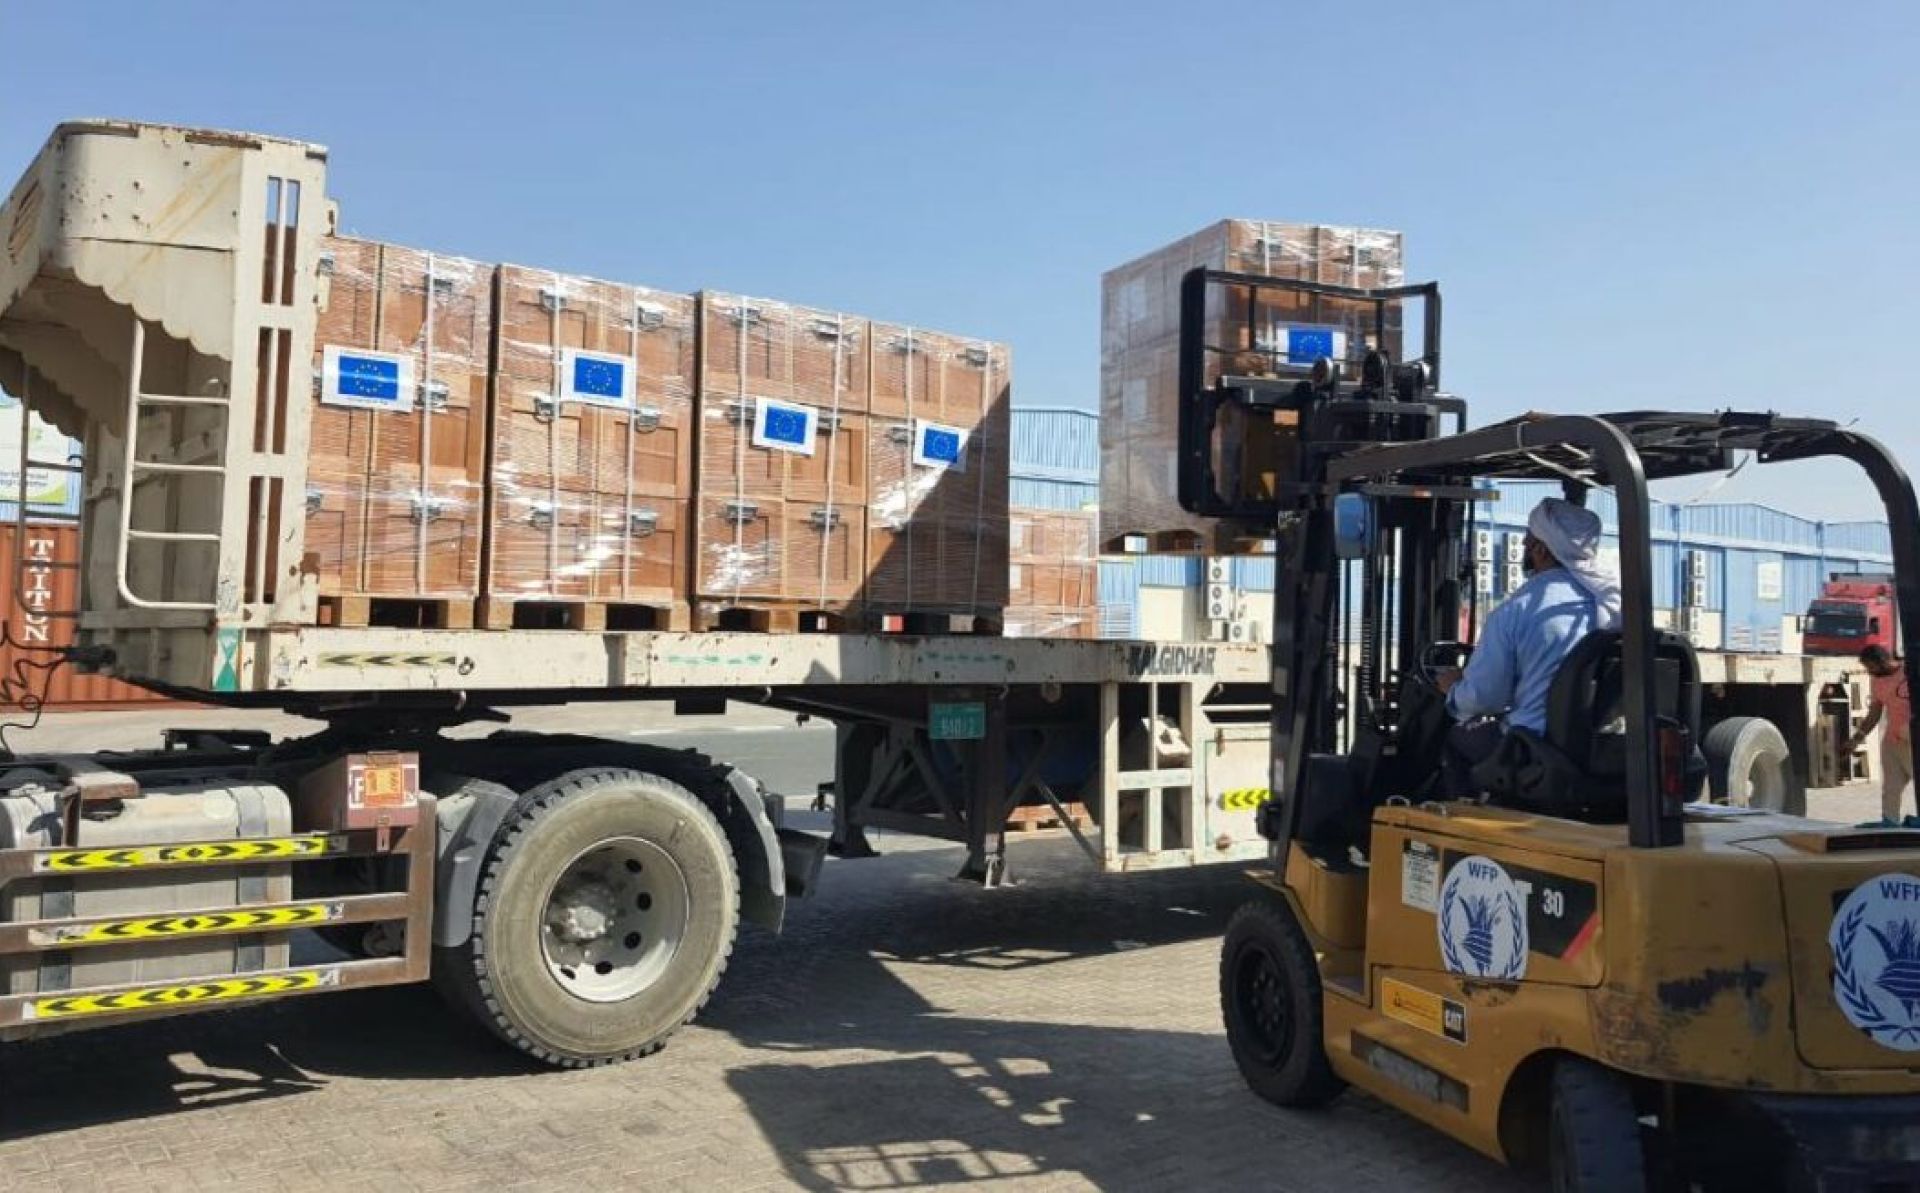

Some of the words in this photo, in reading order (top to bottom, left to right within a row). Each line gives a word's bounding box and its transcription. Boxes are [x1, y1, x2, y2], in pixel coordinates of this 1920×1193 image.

[1467, 860, 1499, 881] WFP
[1542, 887, 1564, 919] 30
[1445, 1007, 1463, 1033] CAT
